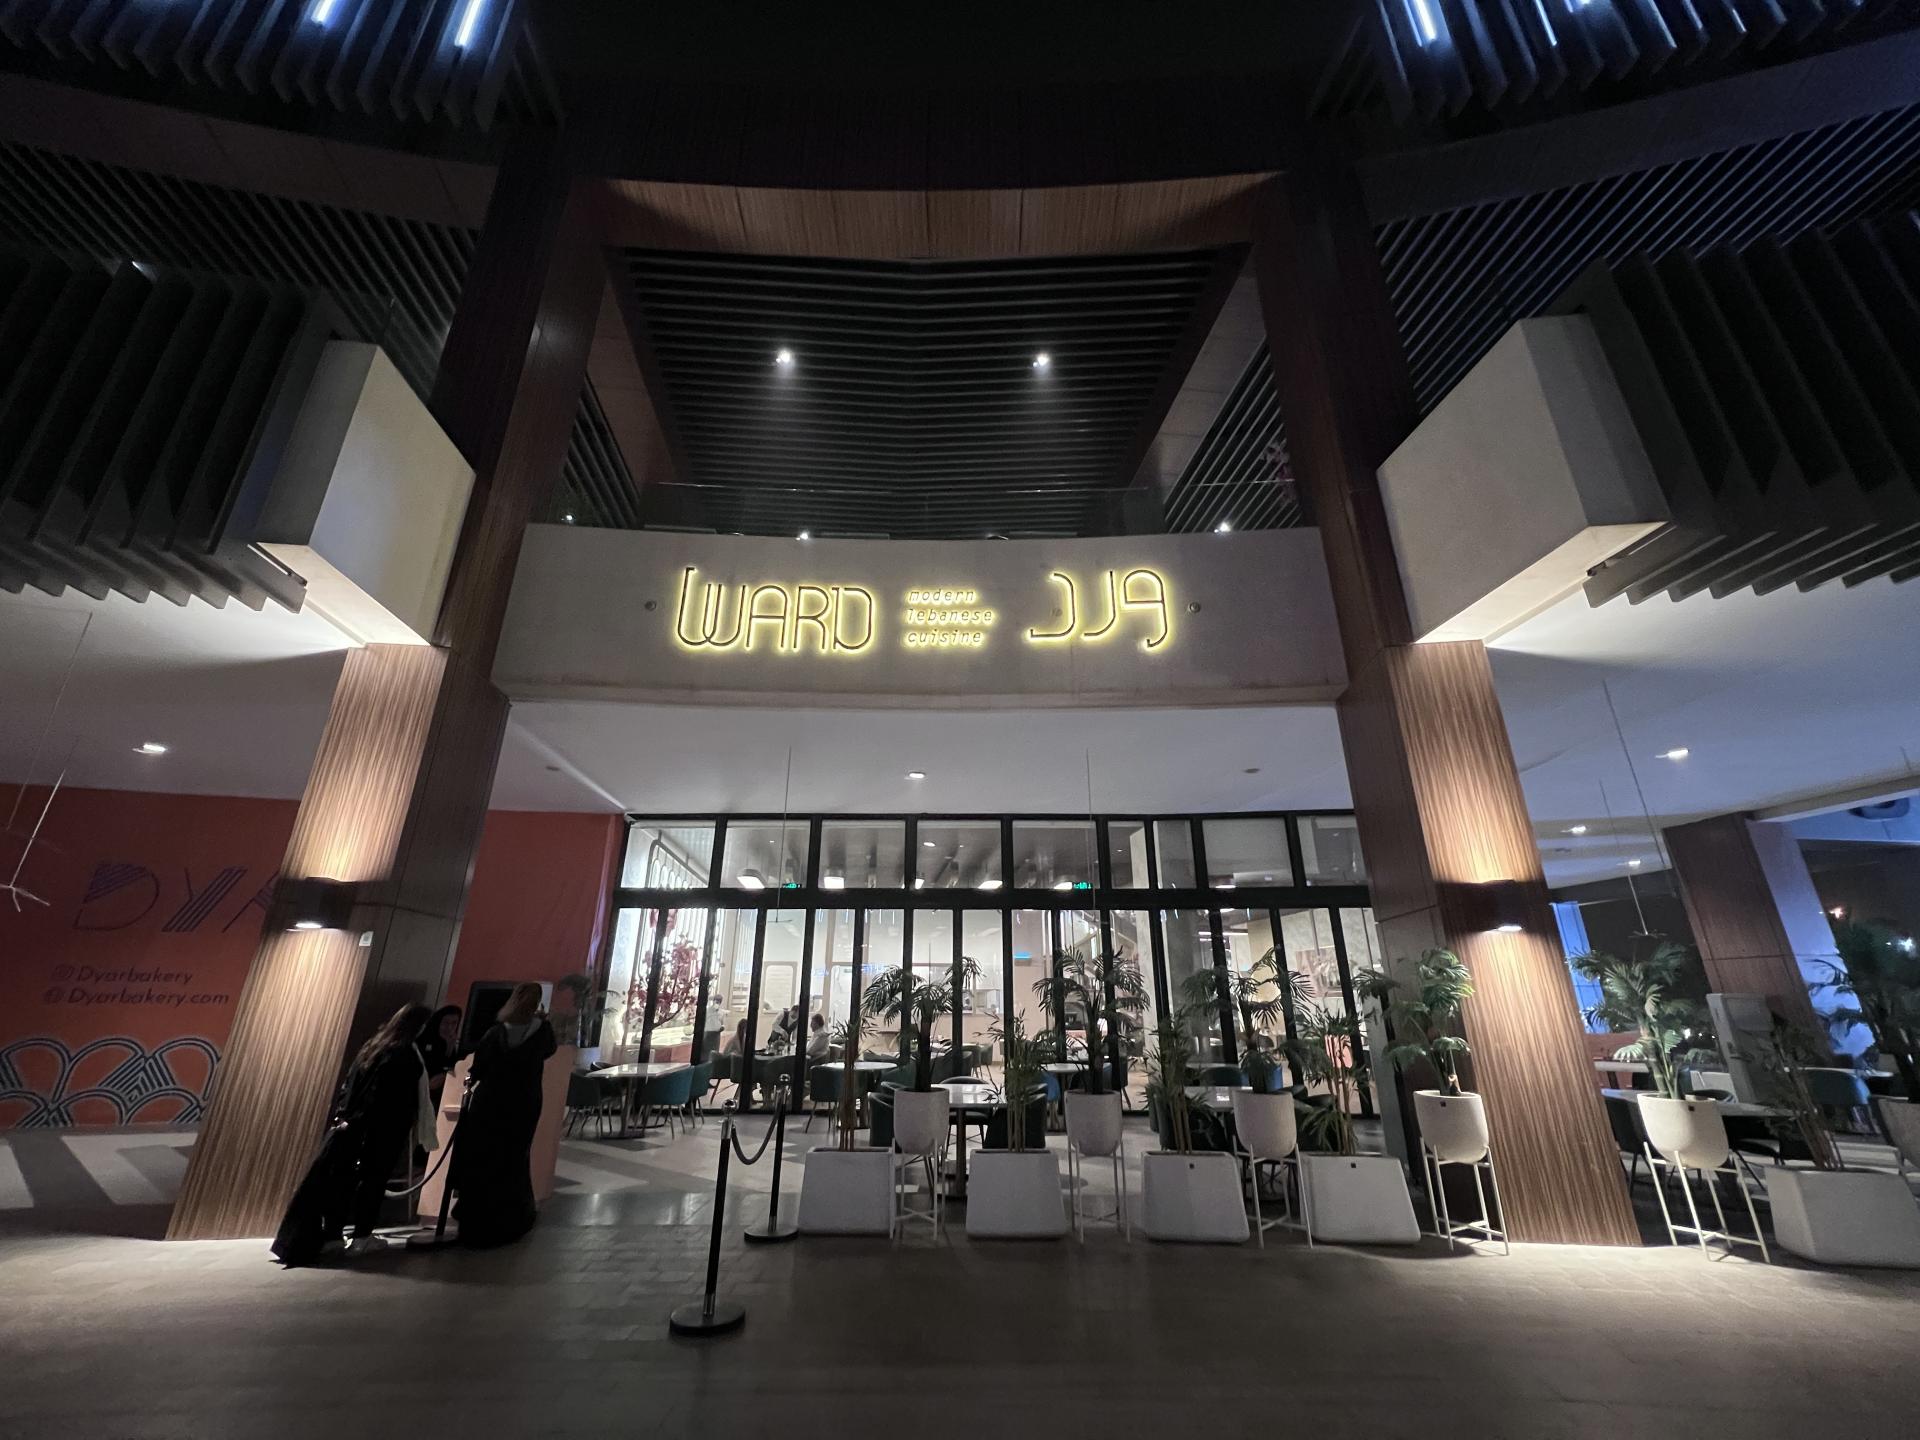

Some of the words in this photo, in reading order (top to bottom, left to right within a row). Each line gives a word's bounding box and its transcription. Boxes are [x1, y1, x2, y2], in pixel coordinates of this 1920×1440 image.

[908, 588, 974, 601] modern
[677, 566, 873, 650] WARD
[907, 608, 993, 621] lebanese
[1030, 569, 1168, 648] ورد
[907, 629, 982, 643] cuisine
